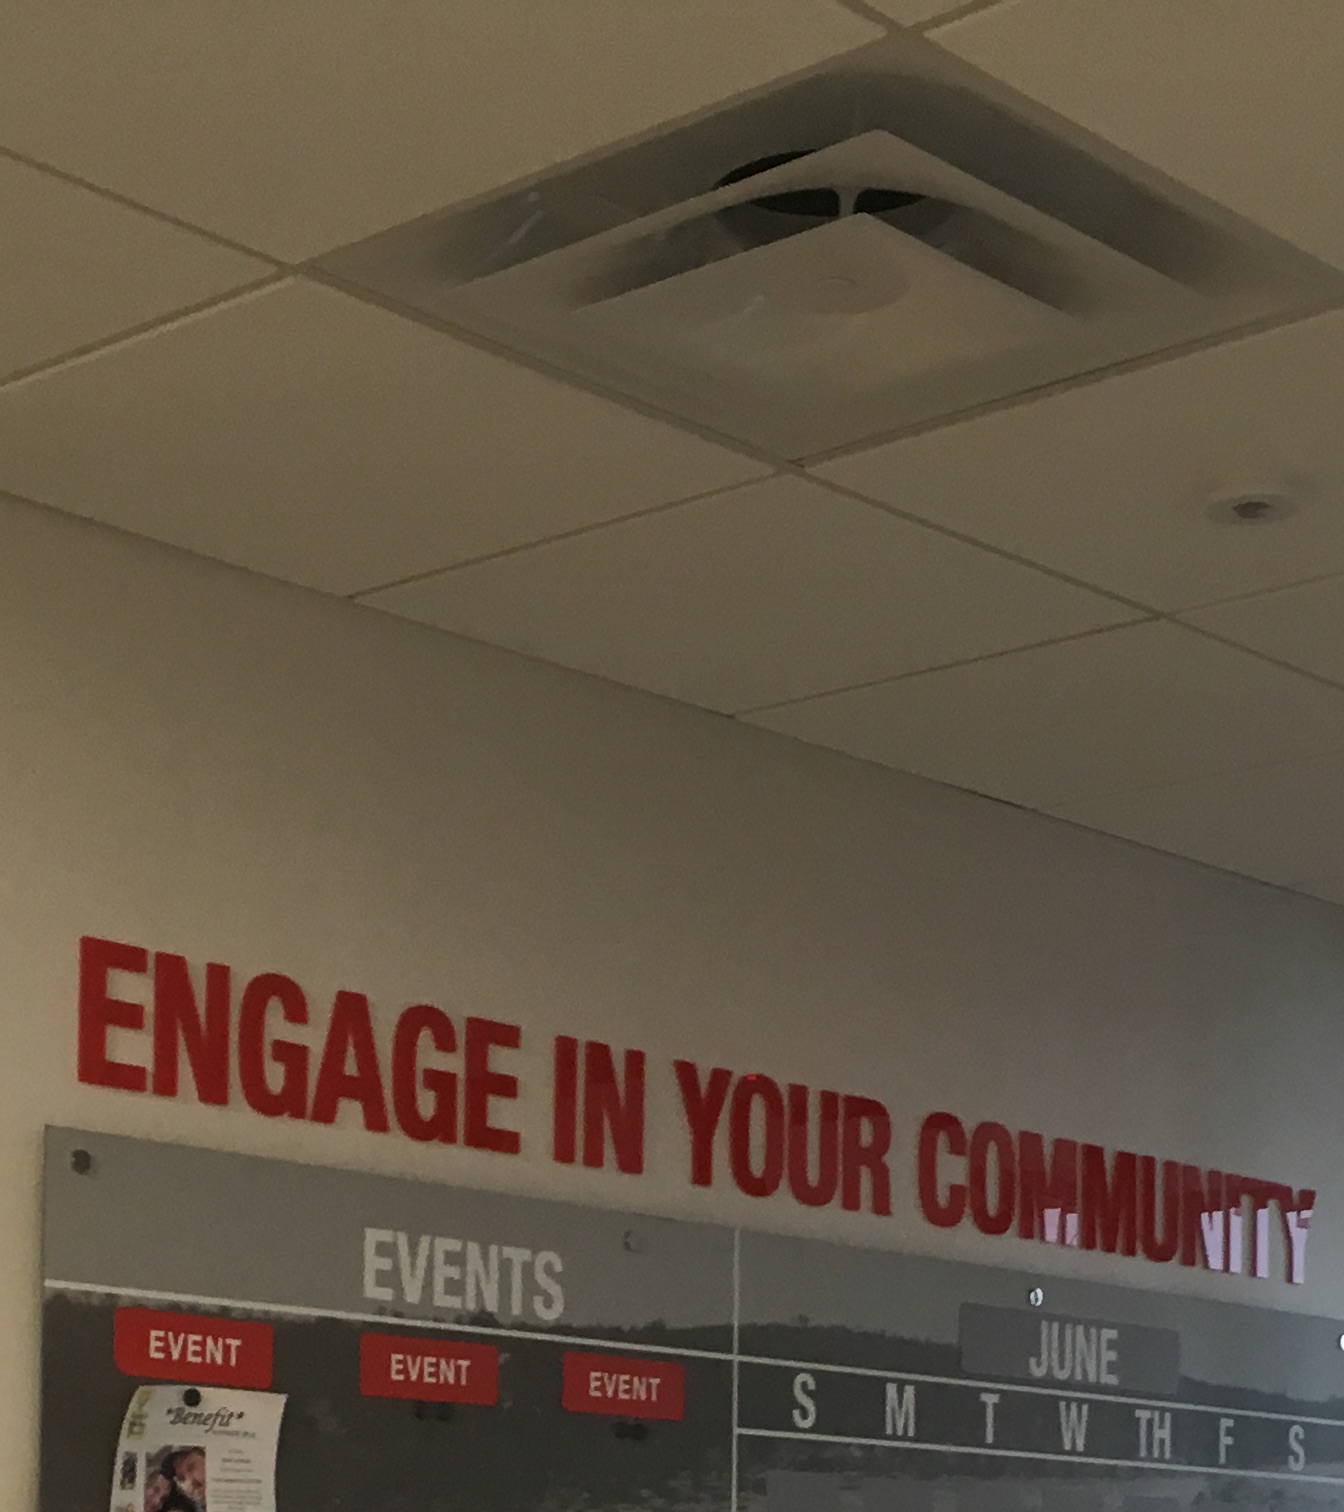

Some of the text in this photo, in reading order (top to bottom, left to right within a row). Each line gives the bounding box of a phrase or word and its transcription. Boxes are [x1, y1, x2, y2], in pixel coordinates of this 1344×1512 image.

[76, 935, 1316, 1285] ENGAGE IN YOUR COMMUNITY
[364, 1228, 563, 1320] EVENTS
[150, 1330, 241, 1366] EVENT
[391, 1354, 470, 1385] EVENT
[1030, 1321, 1118, 1385] JUNE
[590, 1372, 660, 1400] EVENT
[793, 1373, 1306, 1472] S M T W TH F S
